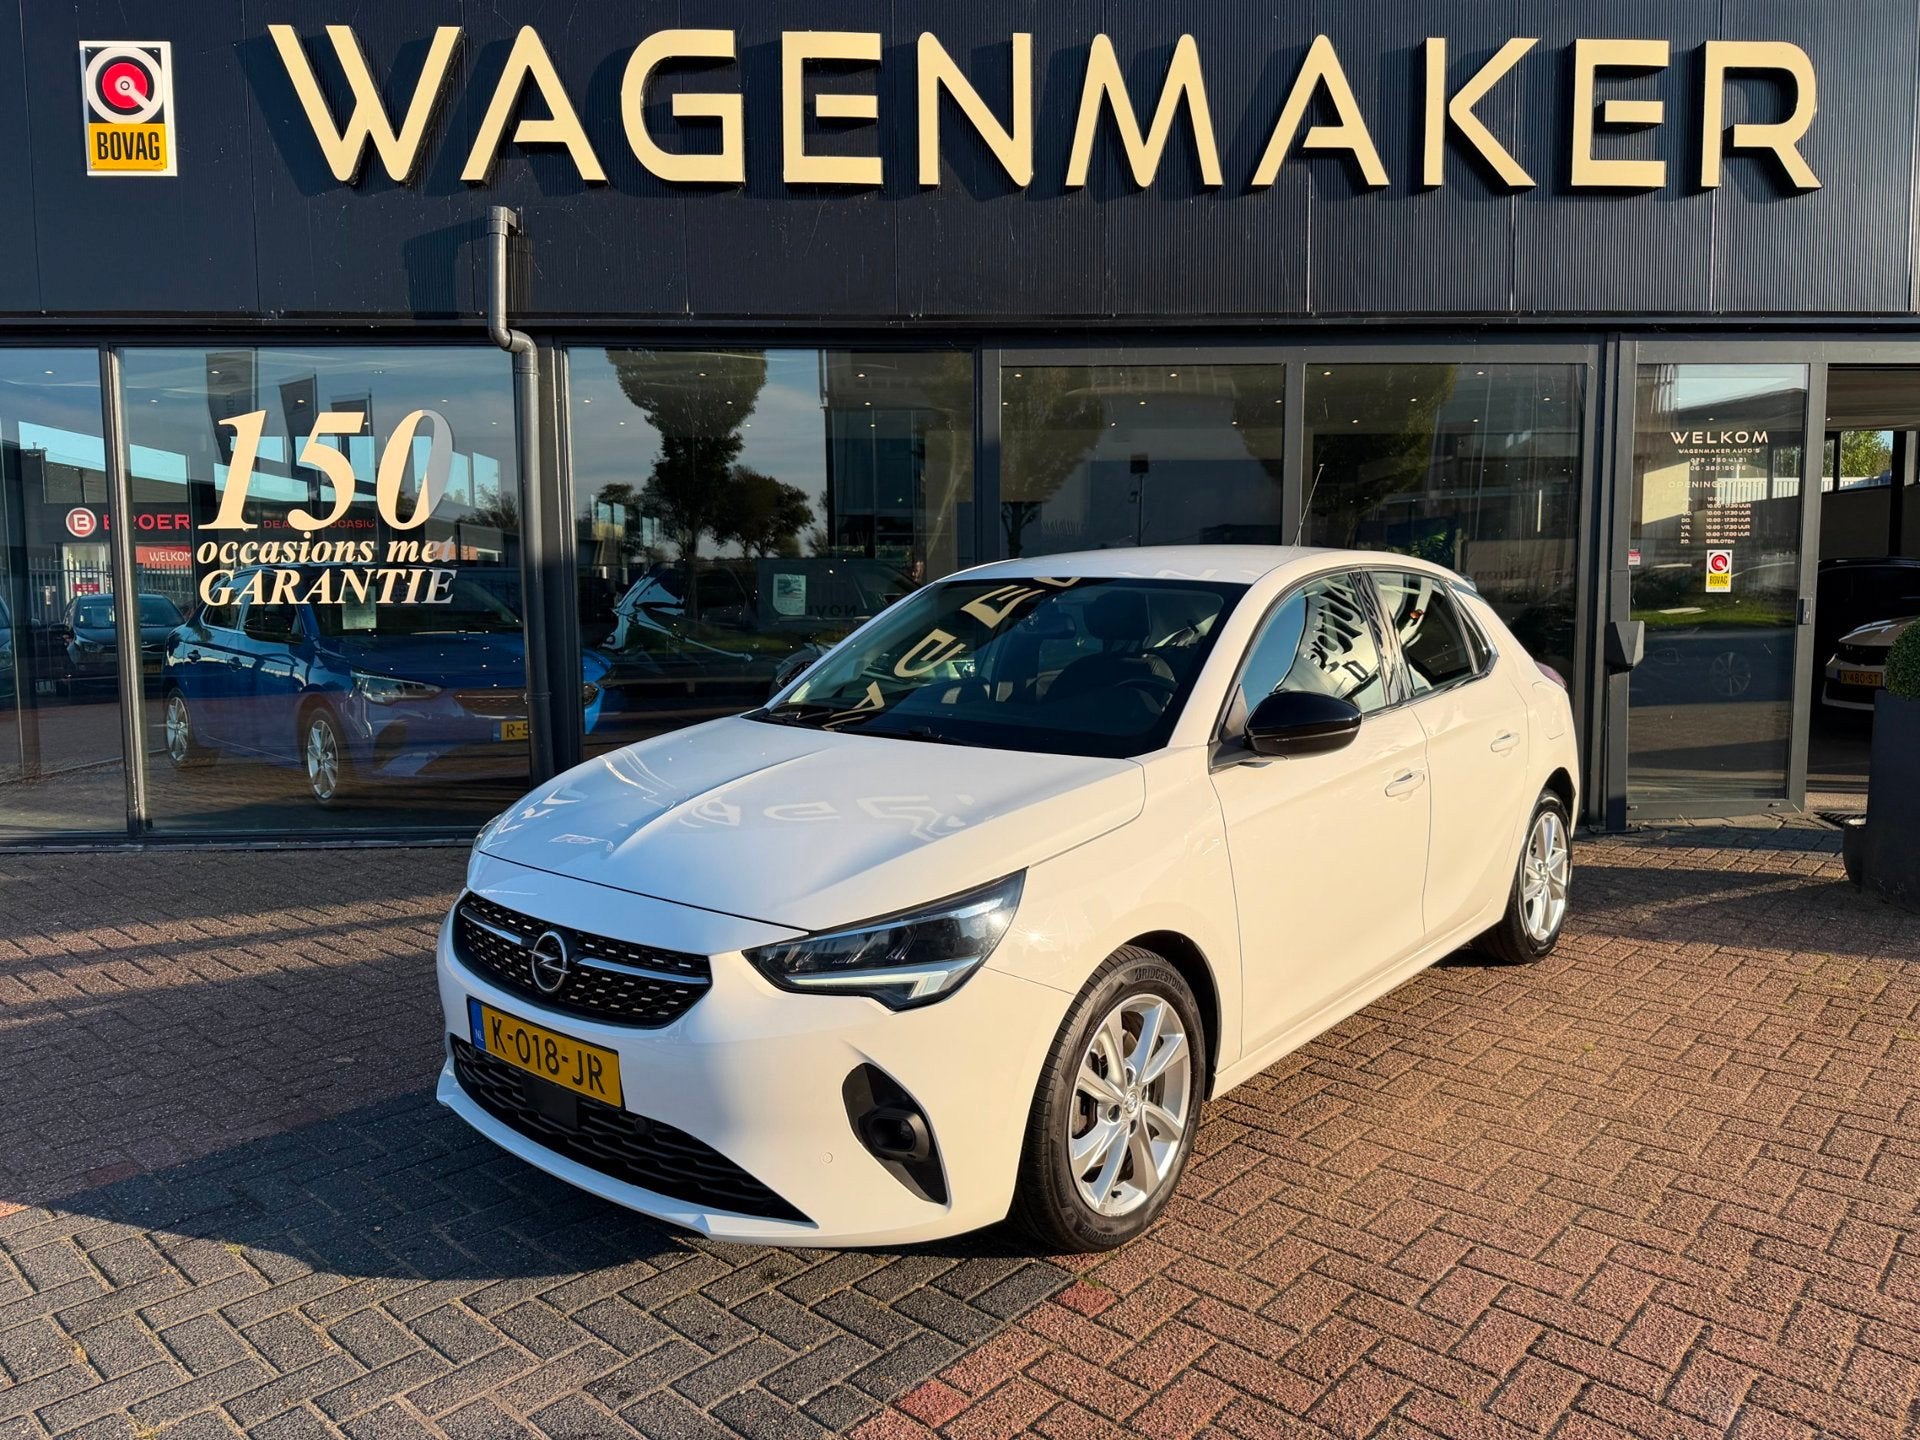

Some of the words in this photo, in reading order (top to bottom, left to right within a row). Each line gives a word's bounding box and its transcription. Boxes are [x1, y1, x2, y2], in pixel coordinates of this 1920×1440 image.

[267, 24, 1822, 188] WAGENMAKER
[96, 131, 160, 161] BOVAG
[1670, 431, 1768, 444] WELKOM
[197, 409, 454, 531] 150
[196, 531, 375, 565] occasions
[386, 535, 454, 564] met
[199, 568, 457, 607] GARANTIE
[1709, 575, 1728, 585] BOVAG
[474, 1028, 485, 1042] NL
[491, 1015, 606, 1095] K-018-JR
